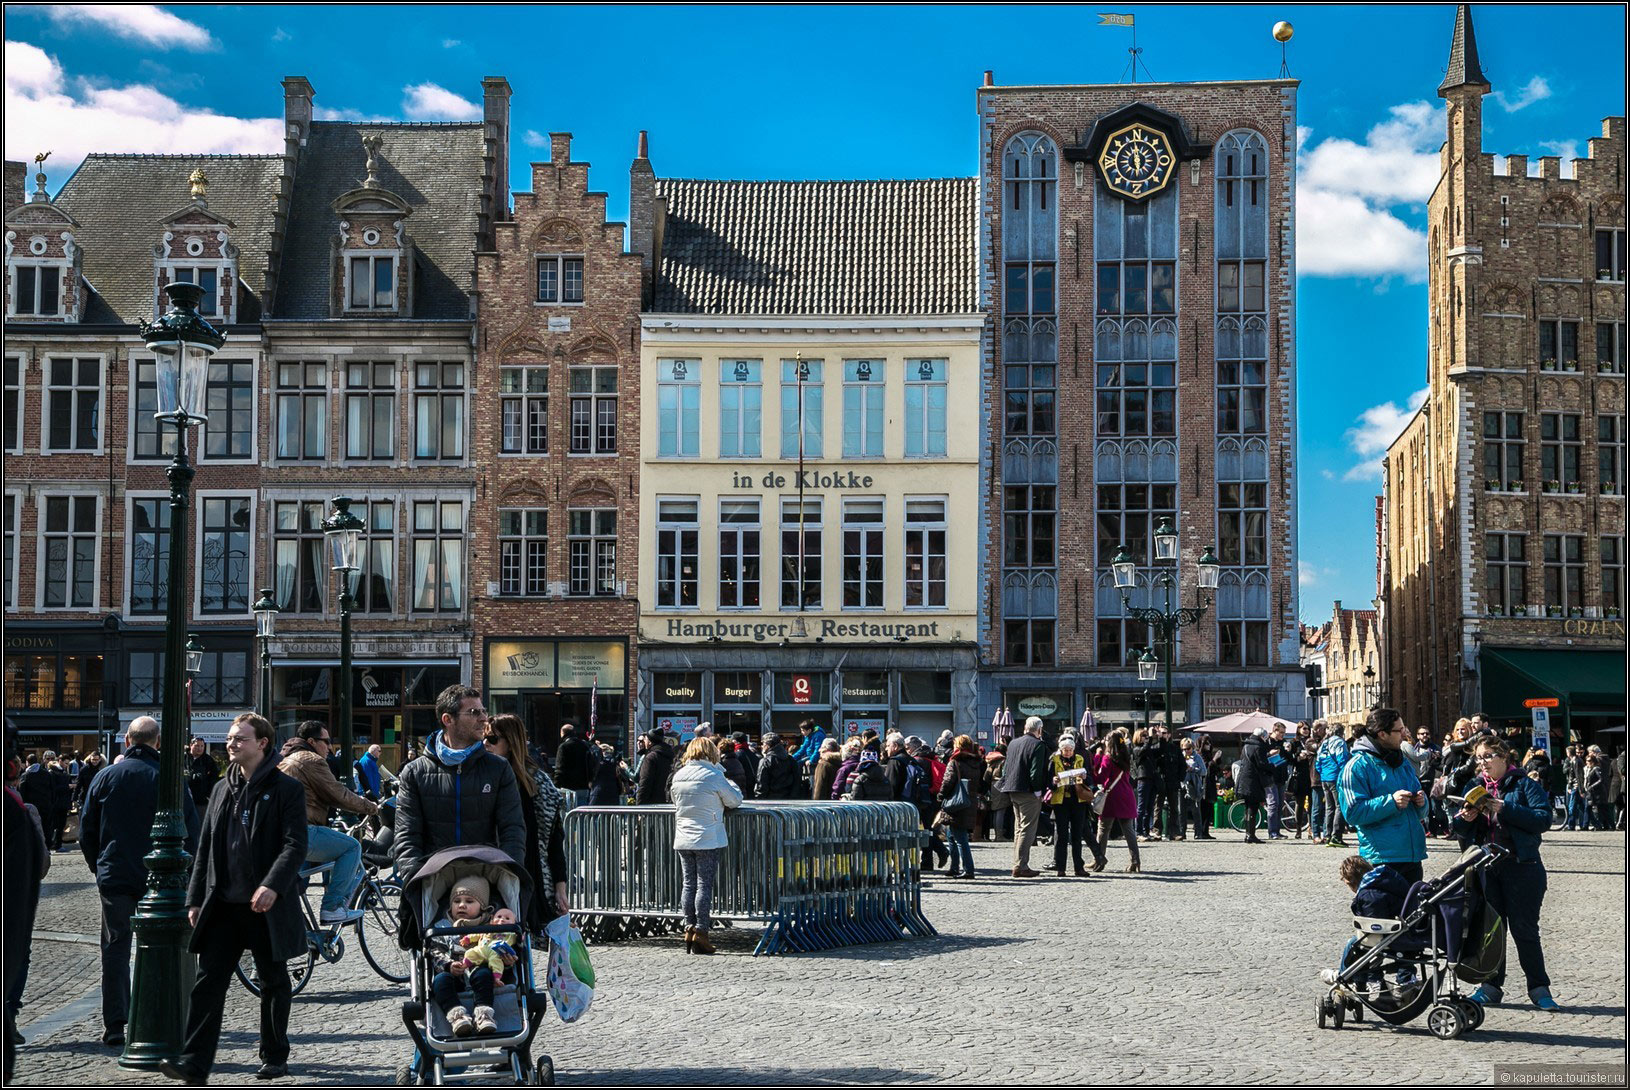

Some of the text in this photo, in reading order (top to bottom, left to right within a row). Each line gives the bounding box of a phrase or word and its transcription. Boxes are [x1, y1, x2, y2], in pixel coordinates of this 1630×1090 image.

[1132, 129, 1141, 140] N
[1105, 155, 1116, 169] W
[1159, 155, 1170, 166] O
[675, 361, 685, 372] Q
[737, 362, 747, 373] Q
[799, 362, 808, 373] Q
[860, 362, 869, 373] Q
[921, 361, 931, 372] Q
[733, 471, 873, 488] in de Klokke
[667, 619, 938, 641] Hamburger Restaurant
[795, 678, 809, 694] Q
[842, 687, 886, 696] Restaurant
[666, 687, 695, 697] Quality
[725, 687, 752, 697] Burger
[1206, 698, 1261, 707] MERIDIAN
